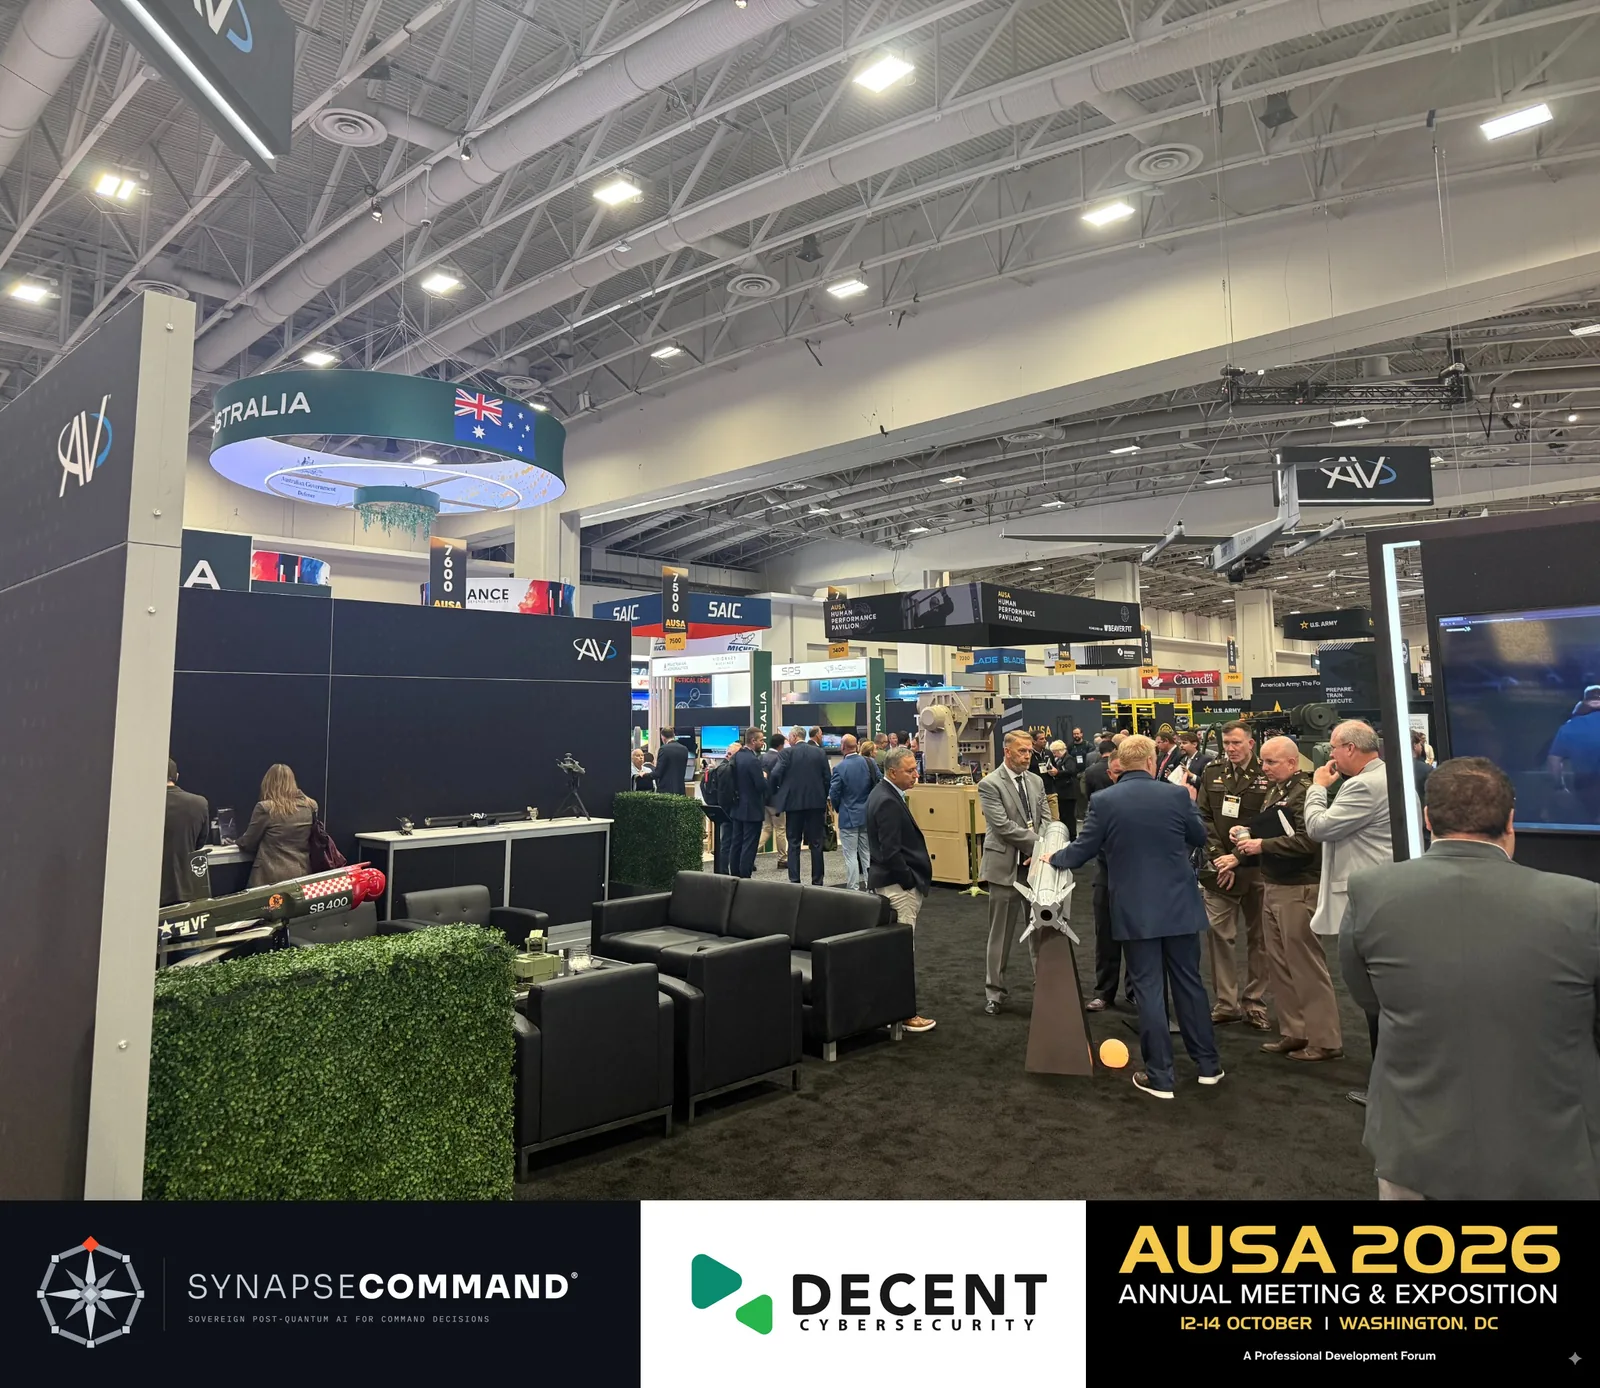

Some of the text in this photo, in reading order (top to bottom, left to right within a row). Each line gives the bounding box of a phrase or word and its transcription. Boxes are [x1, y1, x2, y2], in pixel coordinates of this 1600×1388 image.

[214, 391, 311, 433] STRALIA
[57, 393, 113, 498] AV
[443, 544, 453, 592] 7600
[672, 573, 682, 612] 7500
[708, 602, 743, 618] SAIC
[998, 599, 1017, 607] HUMAN
[613, 604, 640, 621] SAIC
[998, 606, 1036, 617] PERFORMANCE
[998, 613, 1023, 622] PAVILION
[665, 619, 686, 627] AUSA
[831, 614, 877, 625] PERFORMANCE
[573, 638, 617, 661] AV
[1003, 656, 1025, 665] BLADE
[820, 677, 867, 691] BLADE
[1173, 674, 1213, 685] Canada
[309, 896, 348, 914] SB 400
